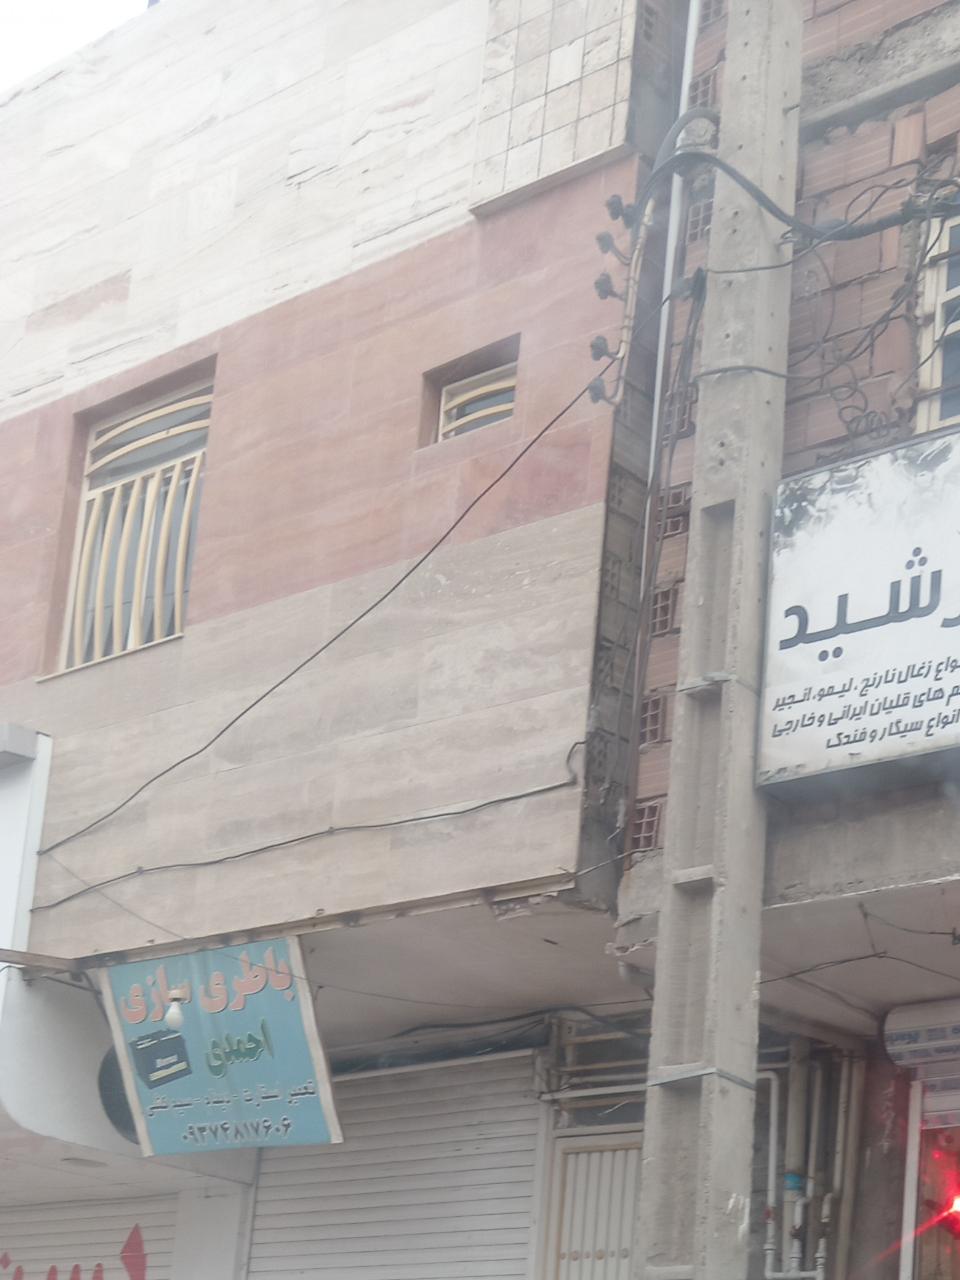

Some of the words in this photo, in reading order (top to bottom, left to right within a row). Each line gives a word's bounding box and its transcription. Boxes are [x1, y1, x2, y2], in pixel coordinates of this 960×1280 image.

[896, 660, 932, 684] زغال
[868, 692, 911, 717] قلیان
[911, 687, 945, 709] های
[771, 712, 816, 738] خارجی
[817, 713, 826, 727] و
[827, 701, 868, 727] ایرانی
[826, 727, 867, 749] فندک
[868, 729, 878, 743] و
[879, 716, 923, 741] سیگار
[201, 947, 295, 1014] باطری
